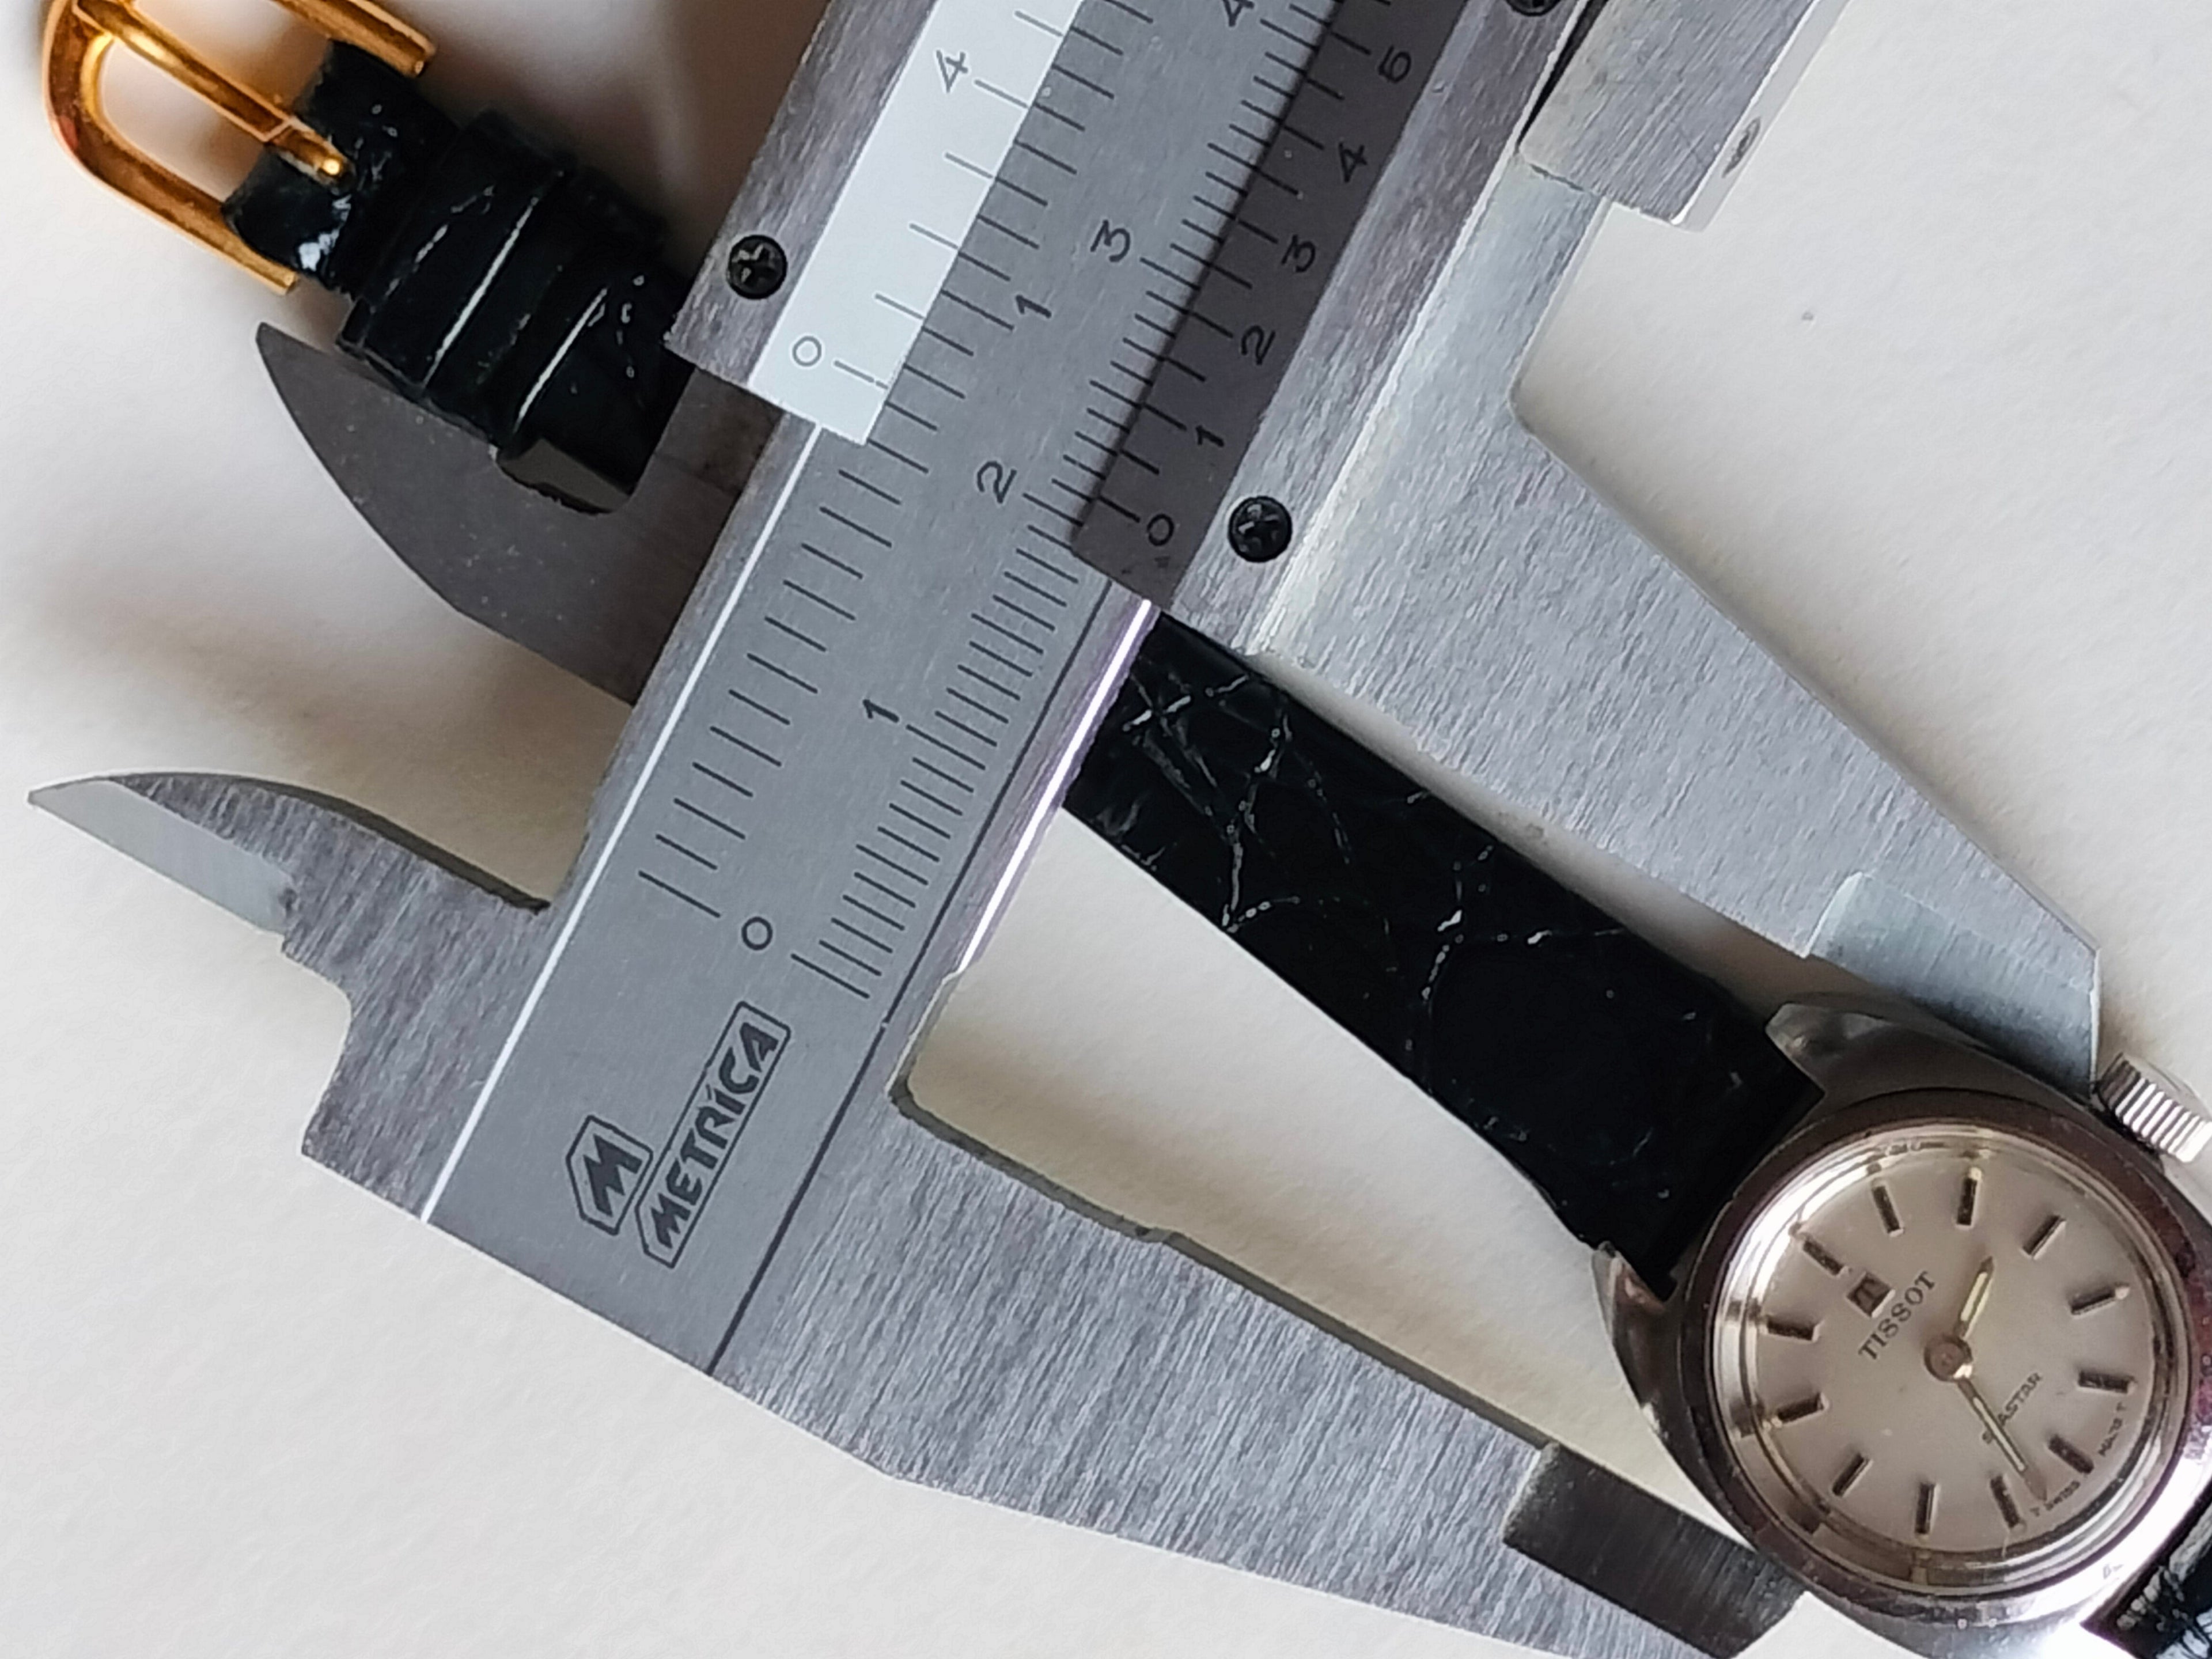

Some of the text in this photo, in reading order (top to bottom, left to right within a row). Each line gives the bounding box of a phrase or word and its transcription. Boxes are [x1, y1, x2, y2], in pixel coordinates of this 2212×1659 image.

[936, 50, 968, 93] 4
[1338, 141, 1368, 183] 4
[1089, 218, 1131, 263] 3
[1281, 234, 1316, 274] 3
[1015, 294, 1052, 319] 1
[791, 335, 822, 367] 0
[1240, 324, 1276, 365] 2
[1195, 425, 1225, 447] 1
[976, 460, 1017, 503] 2
[1146, 513, 1175, 546] 0
[862, 698, 900, 723] 1
[741, 916, 773, 950] 0
[582, 1133, 643, 1218] M
[1857, 1270, 1936, 1360] TISSOT
[1982, 1372, 2043, 1445] SASTAR
